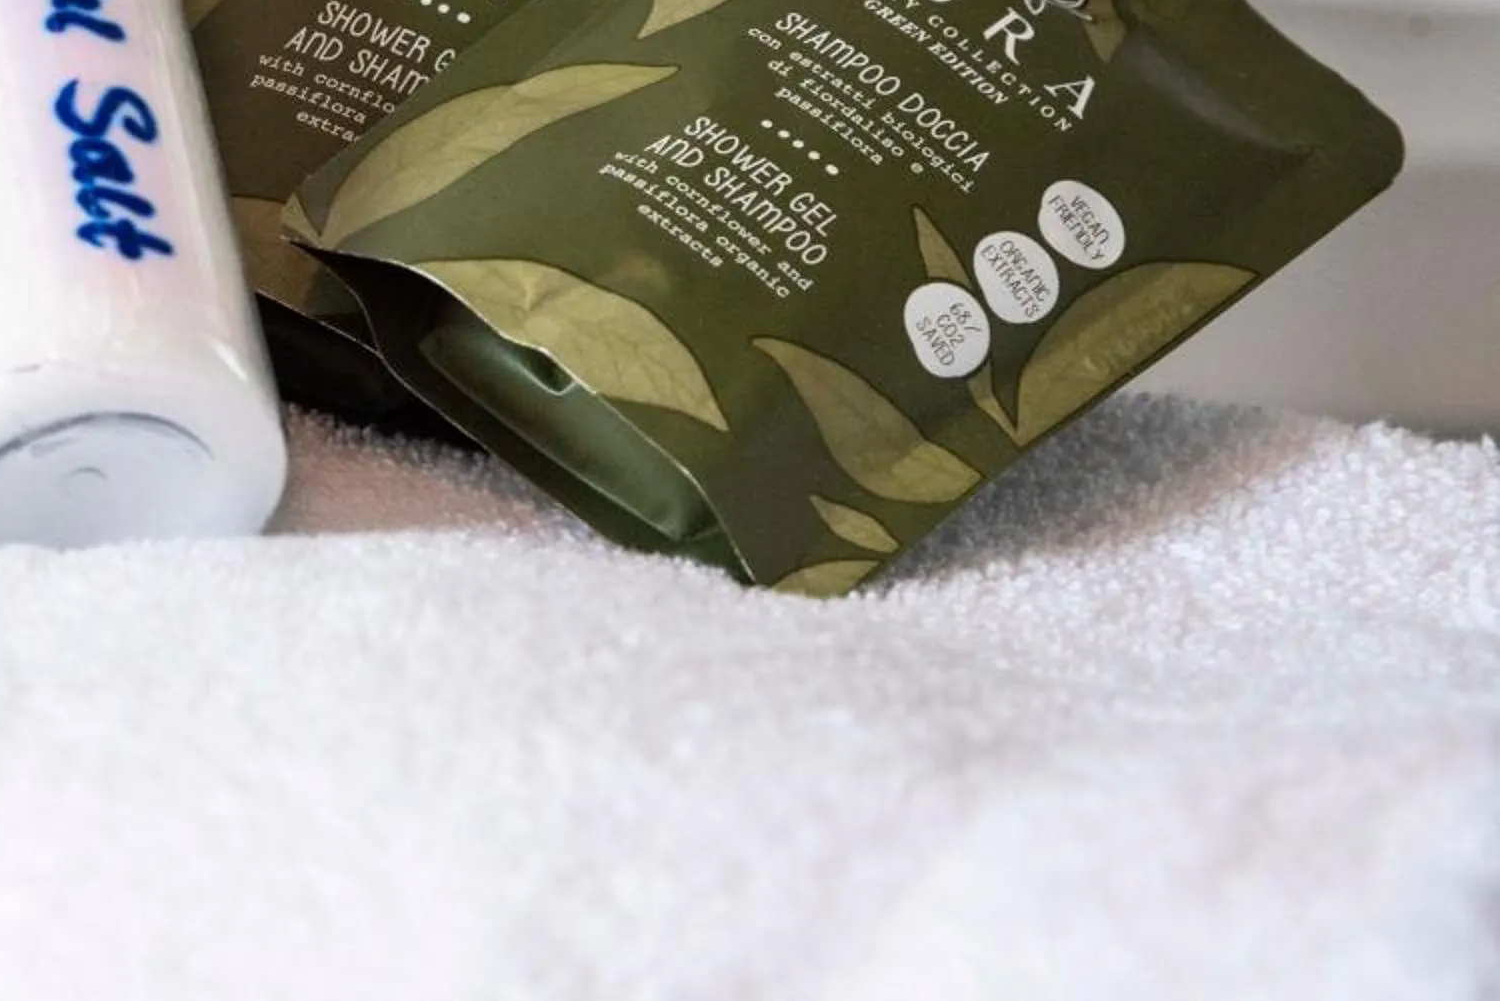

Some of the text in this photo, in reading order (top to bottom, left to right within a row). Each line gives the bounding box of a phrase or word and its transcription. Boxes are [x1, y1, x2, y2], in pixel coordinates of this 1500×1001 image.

[284, 26, 344, 62] AND
[350, 50, 431, 94] SHAM
[317, 0, 431, 63] SHOWER
[250, 74, 366, 124] passiflora
[259, 54, 396, 114] with cornflo
[775, 12, 990, 172] SHAMPOO DOCCIA
[928, 14, 1072, 132] COLLECTION
[928, 42, 1009, 105] EDITION
[296, 111, 360, 142] extra
[748, 27, 976, 194] con estratti biologici
[768, 60, 924, 174] di fiordaliso e
[774, 88, 883, 166] passiflora
[53, 80, 173, 261] Salt
[644, 134, 827, 265] AND SHAMPOO
[684, 116, 837, 237] SHOWER GEL
[598, 163, 790, 298] passiflora organic
[614, 152, 814, 291] with cornflower and
[637, 204, 723, 267] extracts
[1048, 194, 1104, 260] FRIENDLY
[980, 244, 1040, 317] EXTRACTS
[1000, 240, 1050, 302] ORGANIC
[916, 316, 956, 366] SAVED
